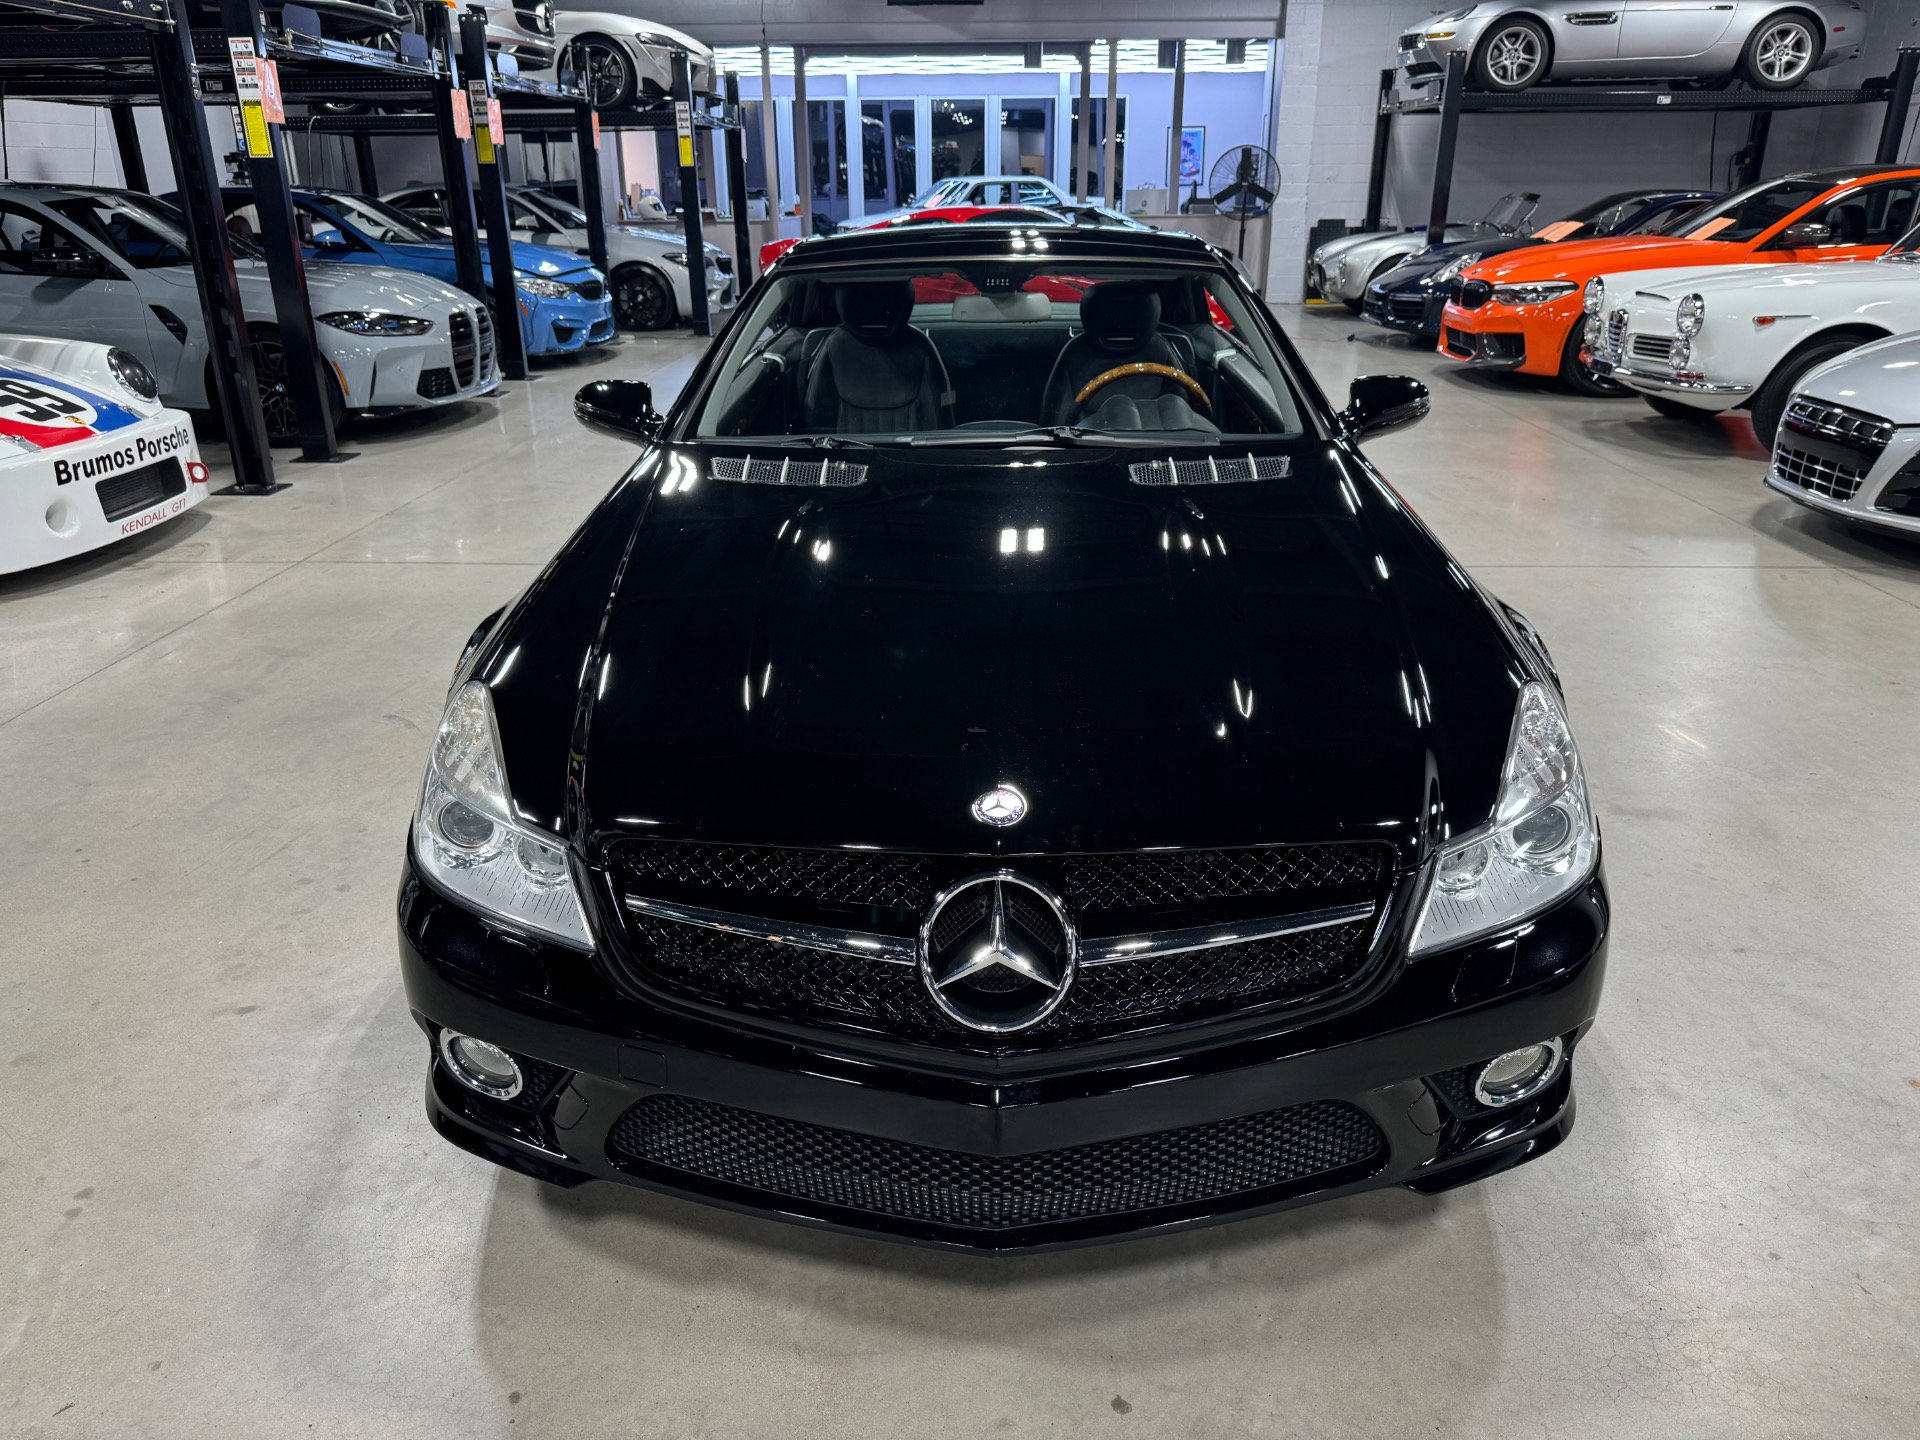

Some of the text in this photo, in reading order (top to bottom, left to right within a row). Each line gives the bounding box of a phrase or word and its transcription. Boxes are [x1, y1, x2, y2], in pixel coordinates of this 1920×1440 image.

[54, 426, 189, 486] Brumos Porsche
[121, 508, 167, 535] KENDALL
